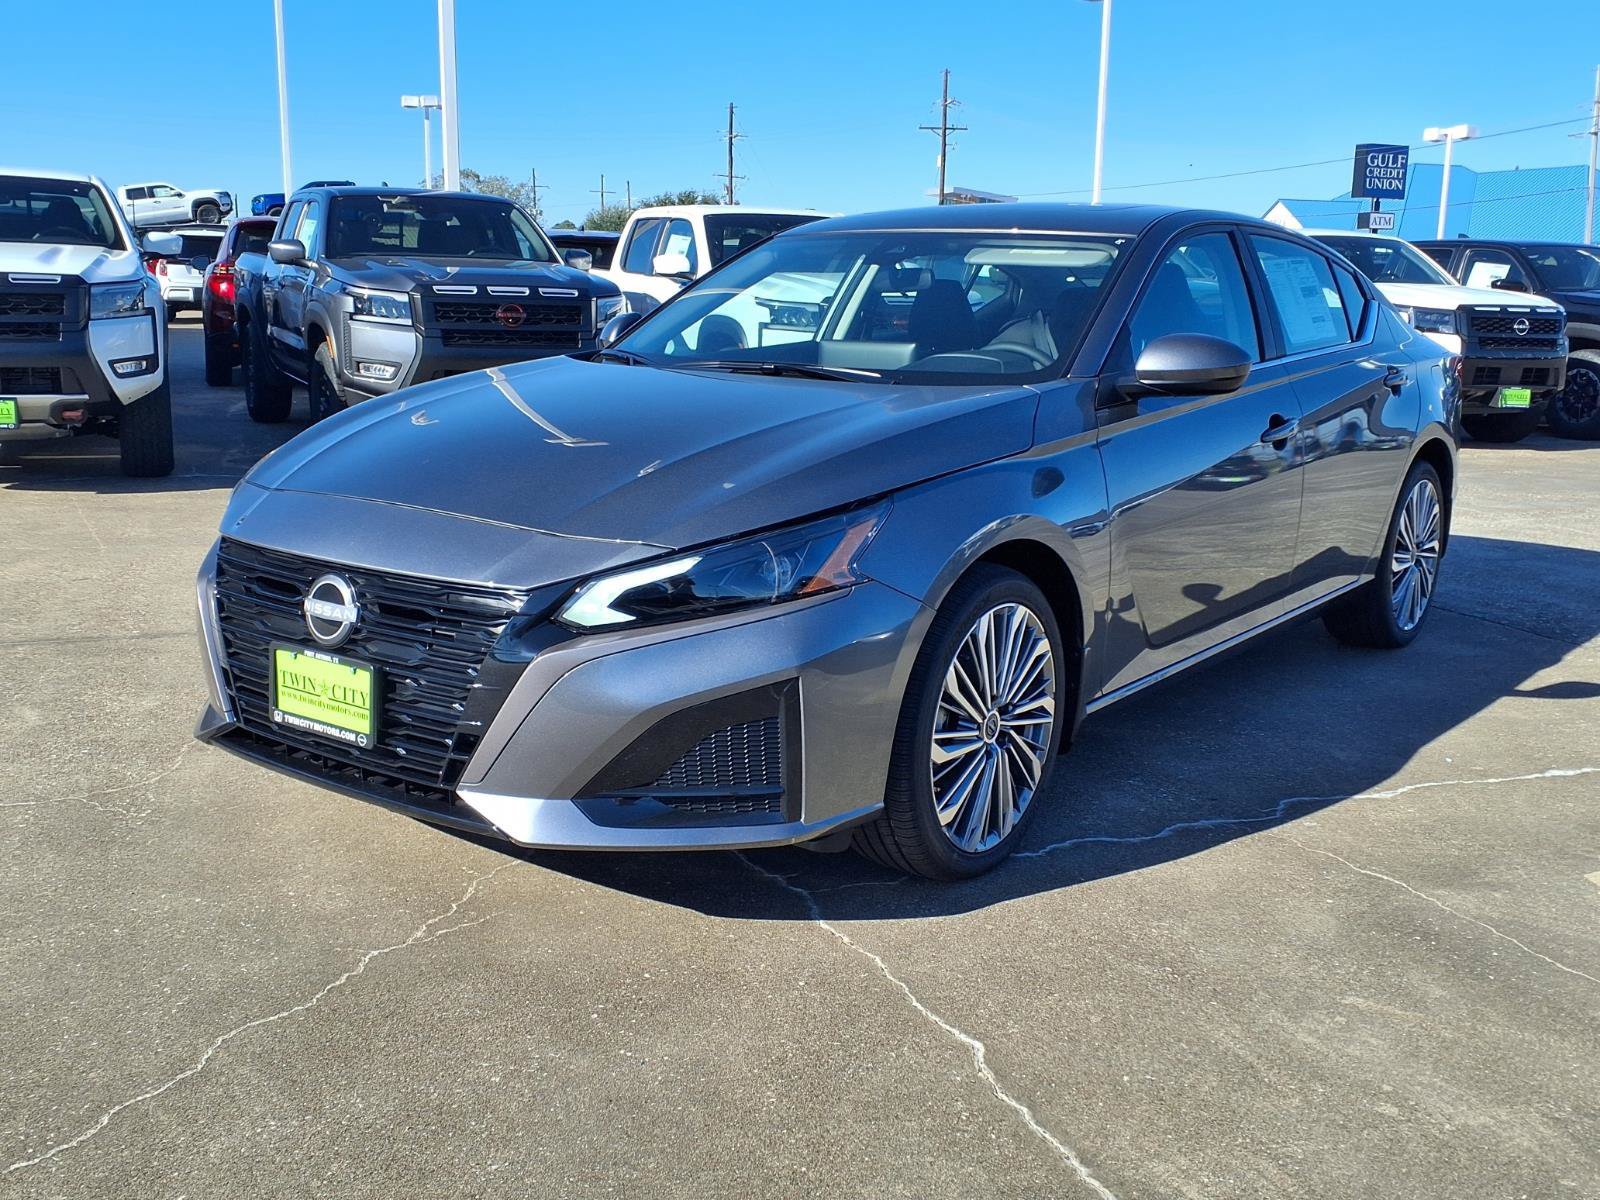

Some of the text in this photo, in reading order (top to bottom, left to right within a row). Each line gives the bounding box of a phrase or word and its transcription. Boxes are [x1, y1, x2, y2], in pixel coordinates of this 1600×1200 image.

[1367, 152, 1407, 168] GULF
[1366, 167, 1405, 179] CREDIT
[1366, 178, 1404, 190] UNION
[1371, 216, 1392, 226] ATM
[304, 599, 356, 622] NISSAN
[280, 669, 368, 707] TWIN CITY
[284, 714, 357, 742] TWINCITYMOTORS.COM
